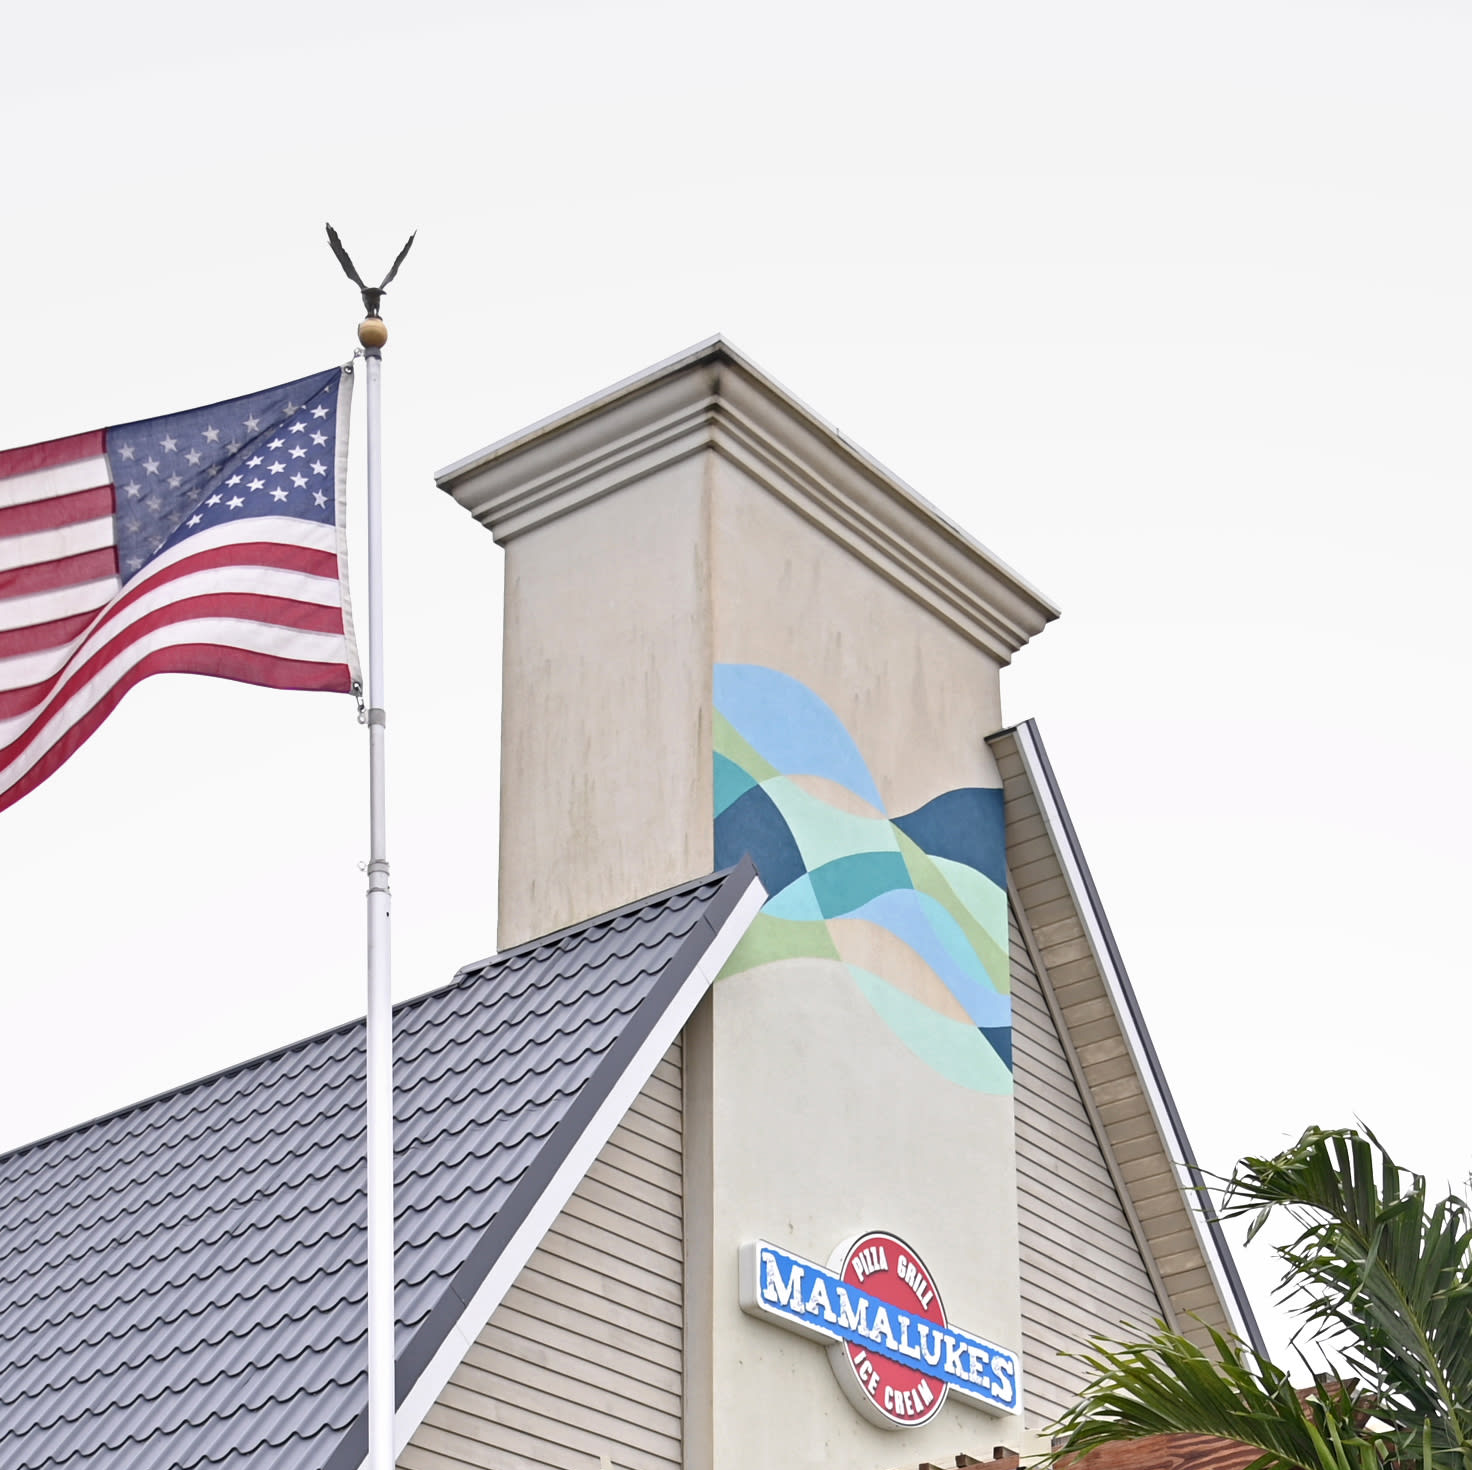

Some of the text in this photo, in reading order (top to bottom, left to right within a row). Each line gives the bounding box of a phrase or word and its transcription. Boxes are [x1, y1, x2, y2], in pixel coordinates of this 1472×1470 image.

[852, 1246, 934, 1310] PIZZA GRILL
[761, 1251, 1014, 1402] MAMALUKES
[853, 1350, 934, 1416] ICE CREAM
